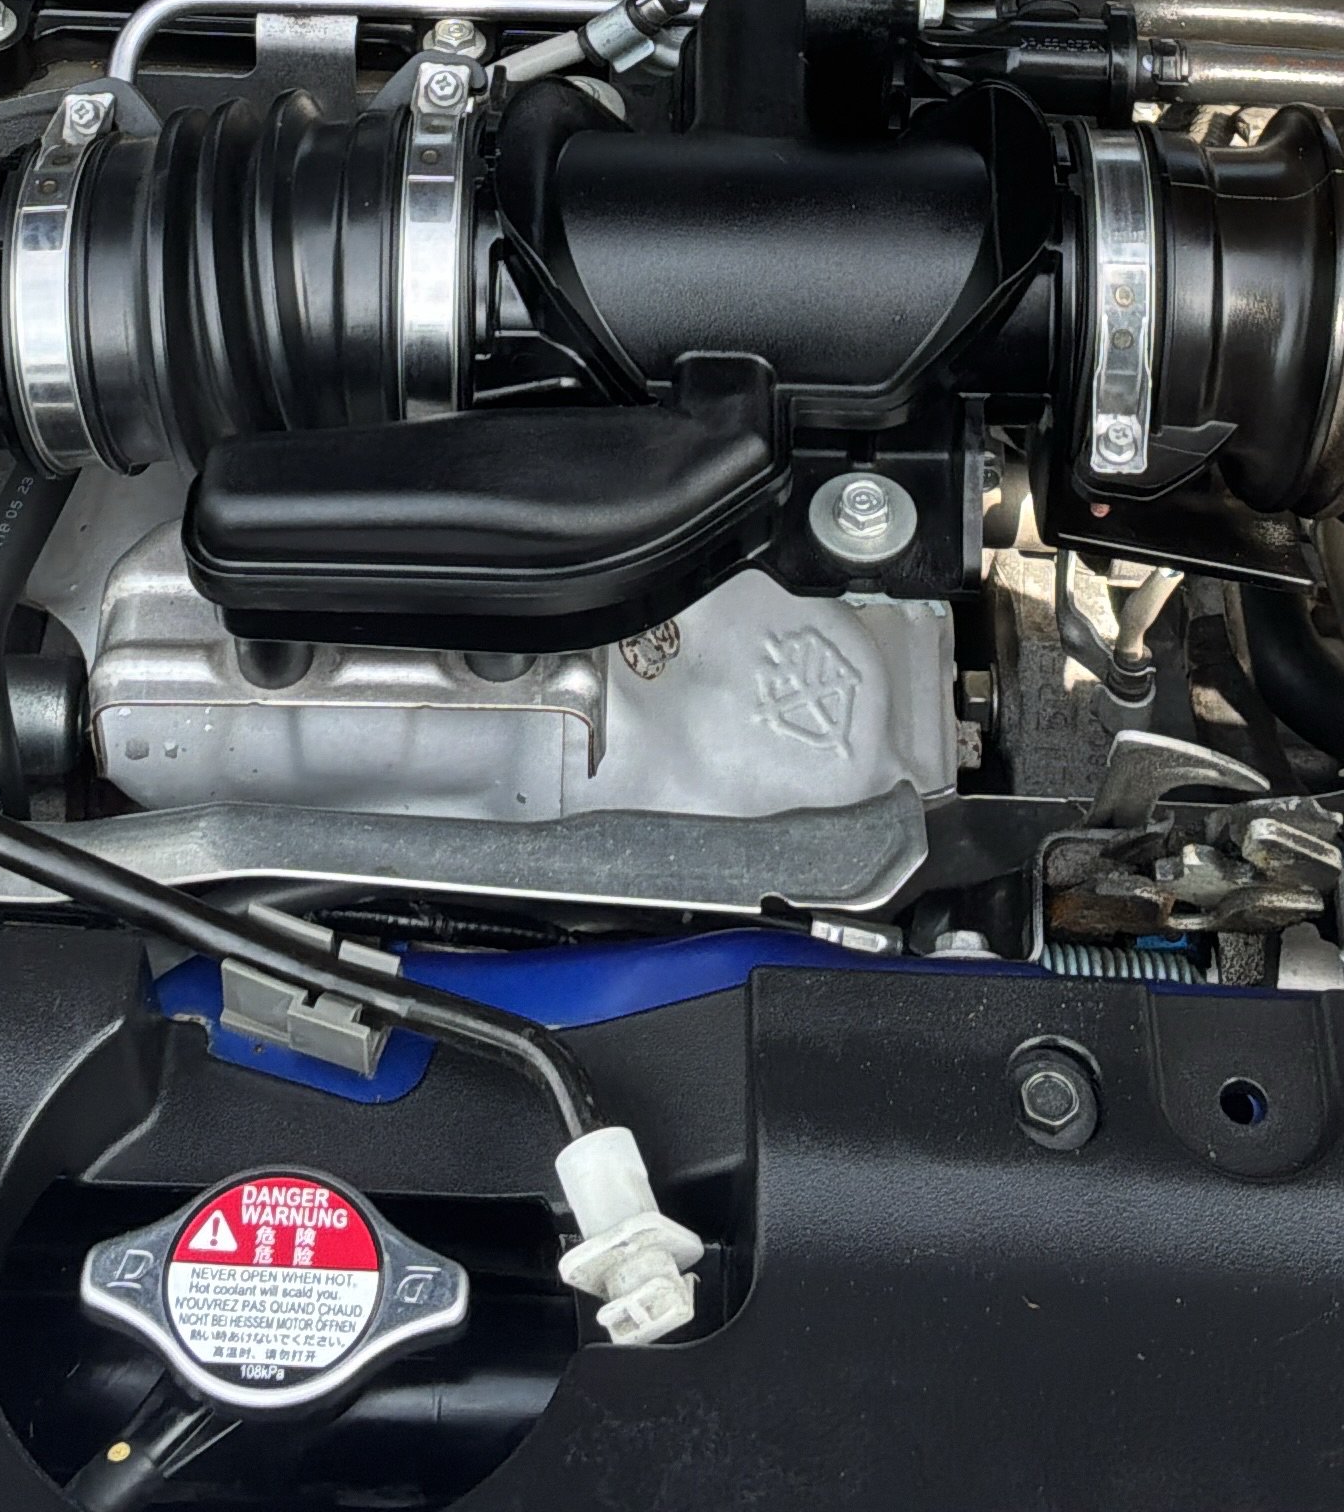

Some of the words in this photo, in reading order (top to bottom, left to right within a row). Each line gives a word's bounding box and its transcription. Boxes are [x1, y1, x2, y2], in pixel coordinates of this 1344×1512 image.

[242, 1185, 330, 1207] DANGER
[241, 1205, 349, 1229] WARNUNG
[191, 1267, 236, 1281] NEVER
[240, 1269, 278, 1284] OPEN
[281, 1271, 322, 1286] WHEN
[188, 1281, 210, 1294] Hot
[213, 1283, 256, 1296] coolant
[260, 1285, 278, 1297] will
[282, 1286, 312, 1299] scald
[317, 1289, 341, 1302] you.
[175, 1296, 238, 1313] N'OUVREZ
[242, 1298, 267, 1312] PAS
[270, 1300, 315, 1315] QUAND
[179, 1312, 209, 1326] NICHT
[211, 1314, 228, 1327] BEI
[229, 1315, 274, 1329] HEISSEM
[276, 1316, 313, 1331] MOTOR
[315, 1316, 357, 1333] ÖFFNEN
[240, 1364, 285, 1381] 108kPa
